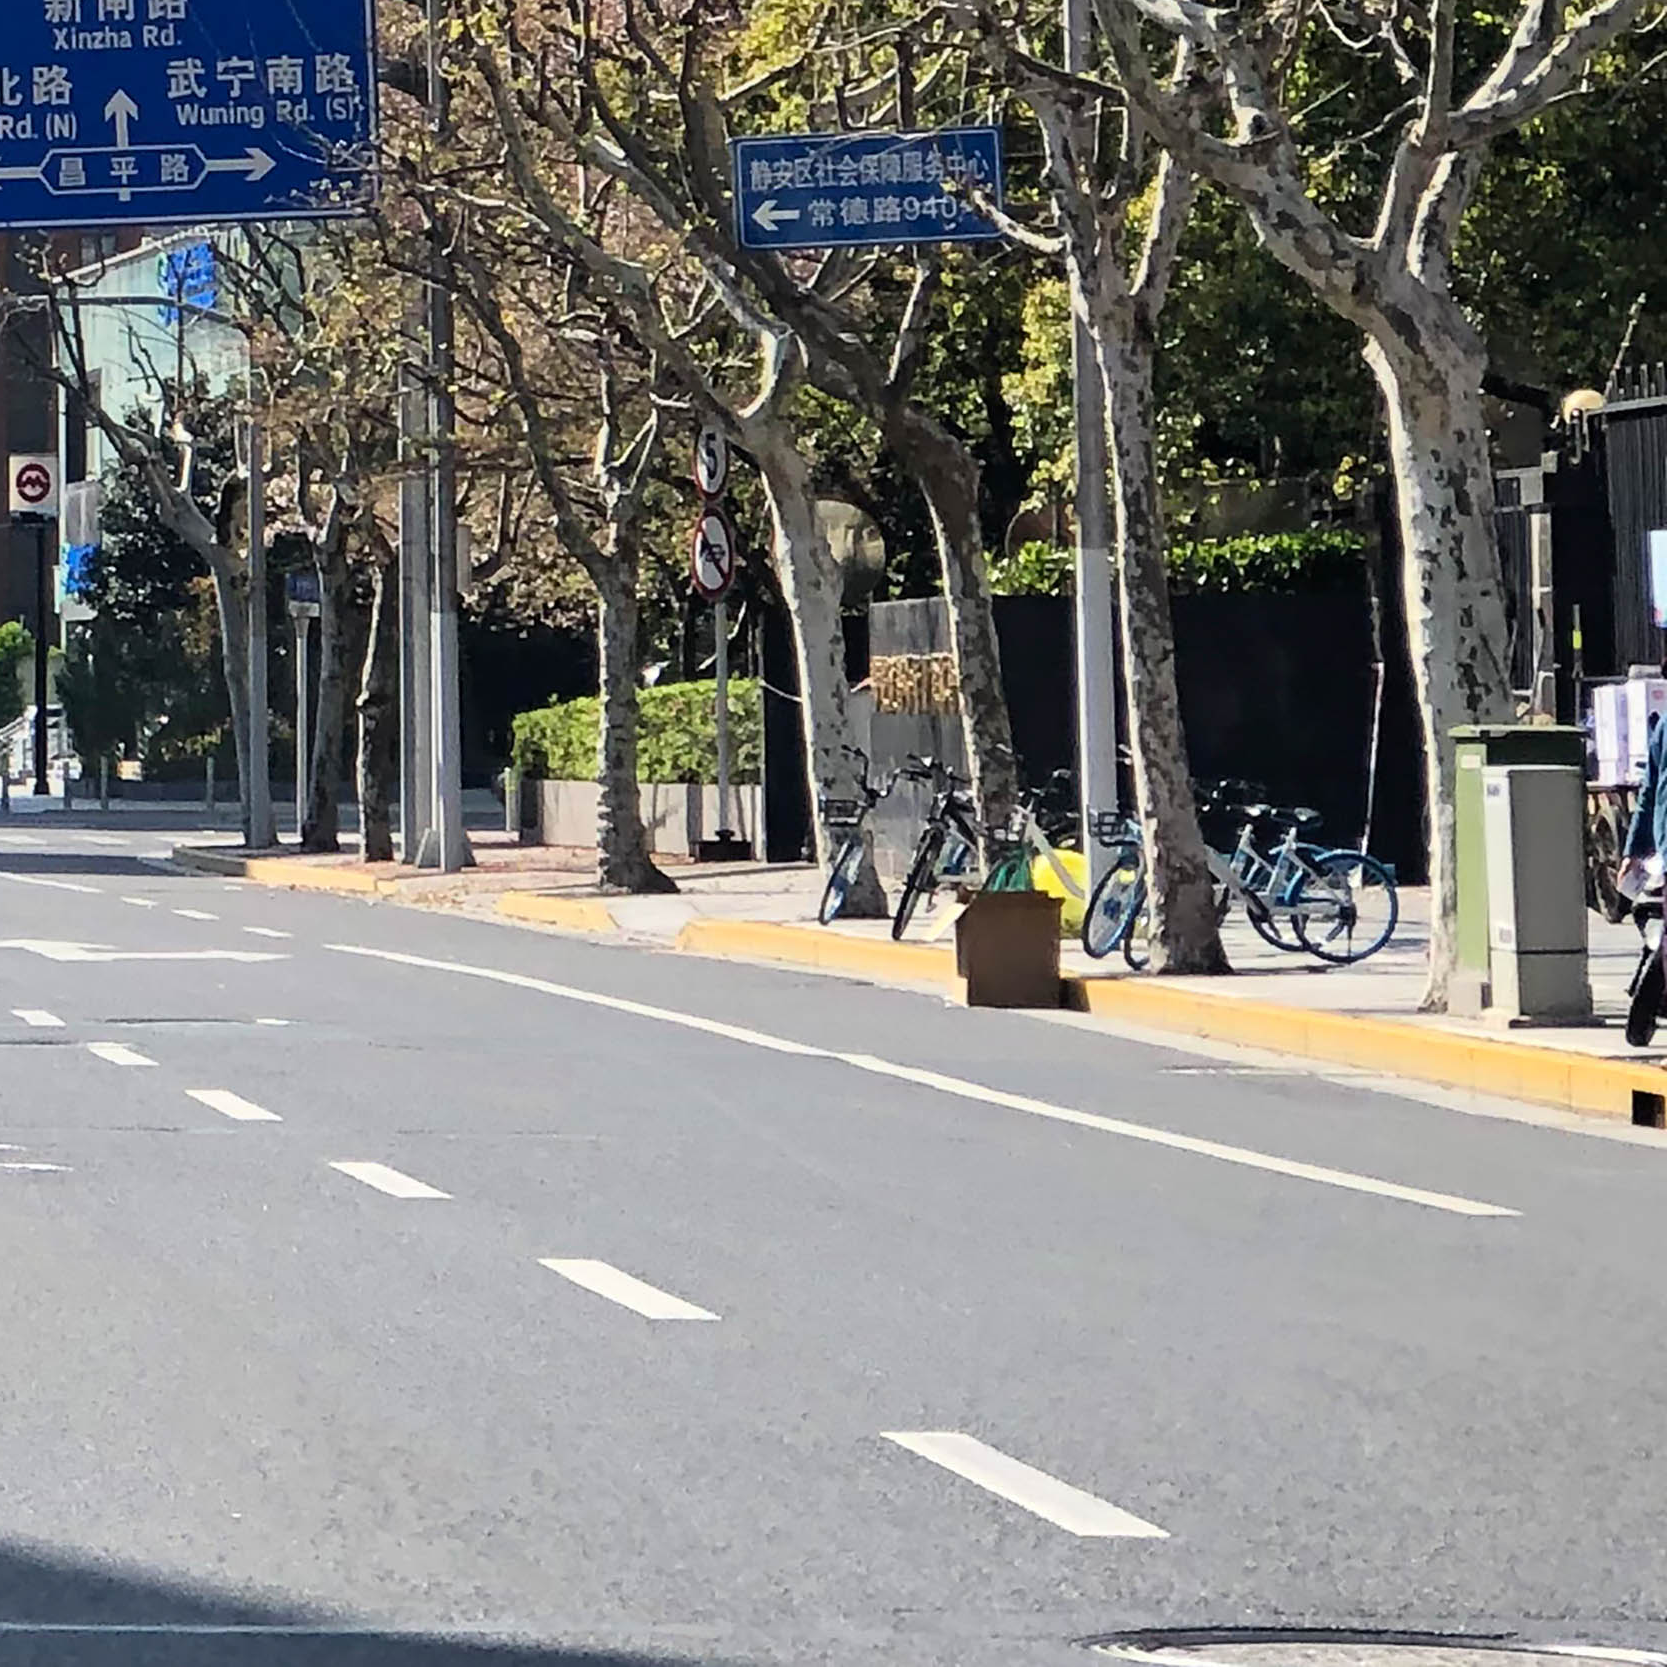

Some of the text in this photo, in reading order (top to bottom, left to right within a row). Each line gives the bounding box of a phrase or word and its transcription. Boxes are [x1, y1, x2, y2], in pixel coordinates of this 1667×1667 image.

[53, 23, 183, 51] Xinzha Rd.
[167, 52, 355, 99] 武宁南路
[45, 113, 77, 141] (N)
[176, 96, 355, 129] Wuning Rd. (S)
[58, 154, 190, 187] 昌平路
[808, 195, 975, 227] 常德路940
